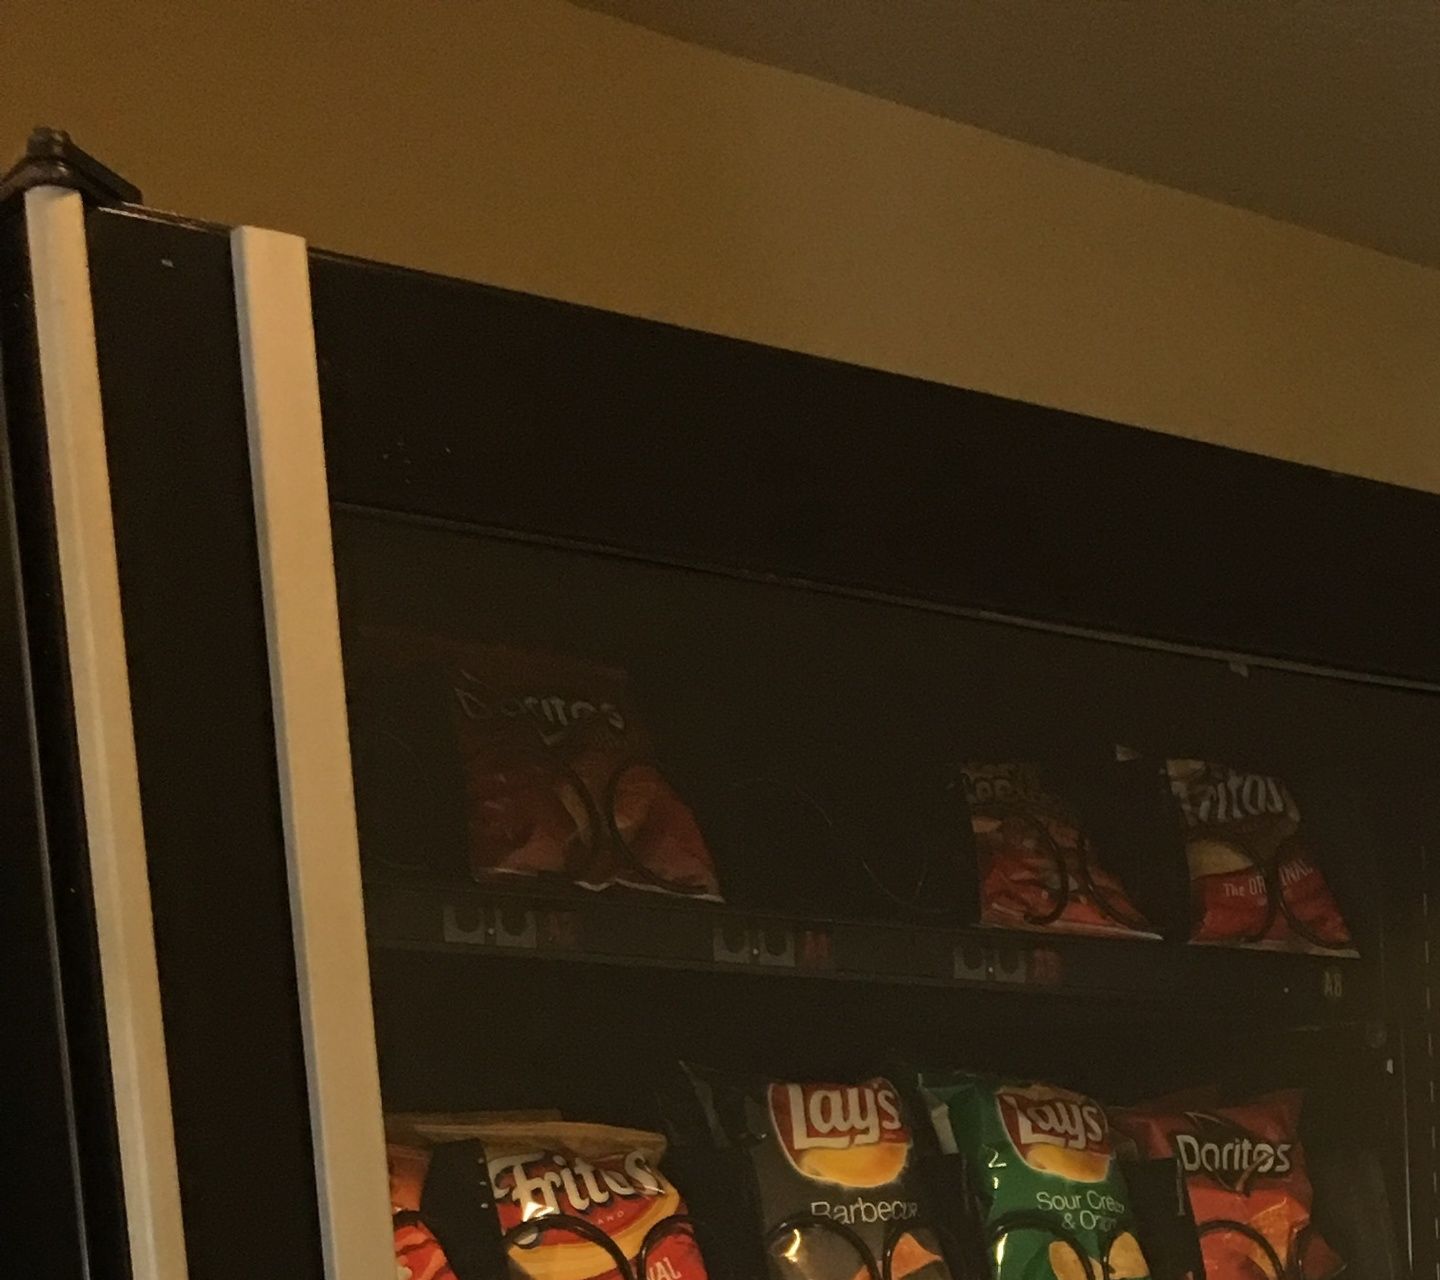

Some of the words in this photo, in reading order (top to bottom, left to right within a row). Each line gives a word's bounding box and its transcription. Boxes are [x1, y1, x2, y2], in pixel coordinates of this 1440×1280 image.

[788, 1083, 902, 1150] Lay's
[1176, 1134, 1291, 1173] Doritos
[491, 1150, 667, 1221] Fritos
[1036, 1191, 1081, 1211] Sour
